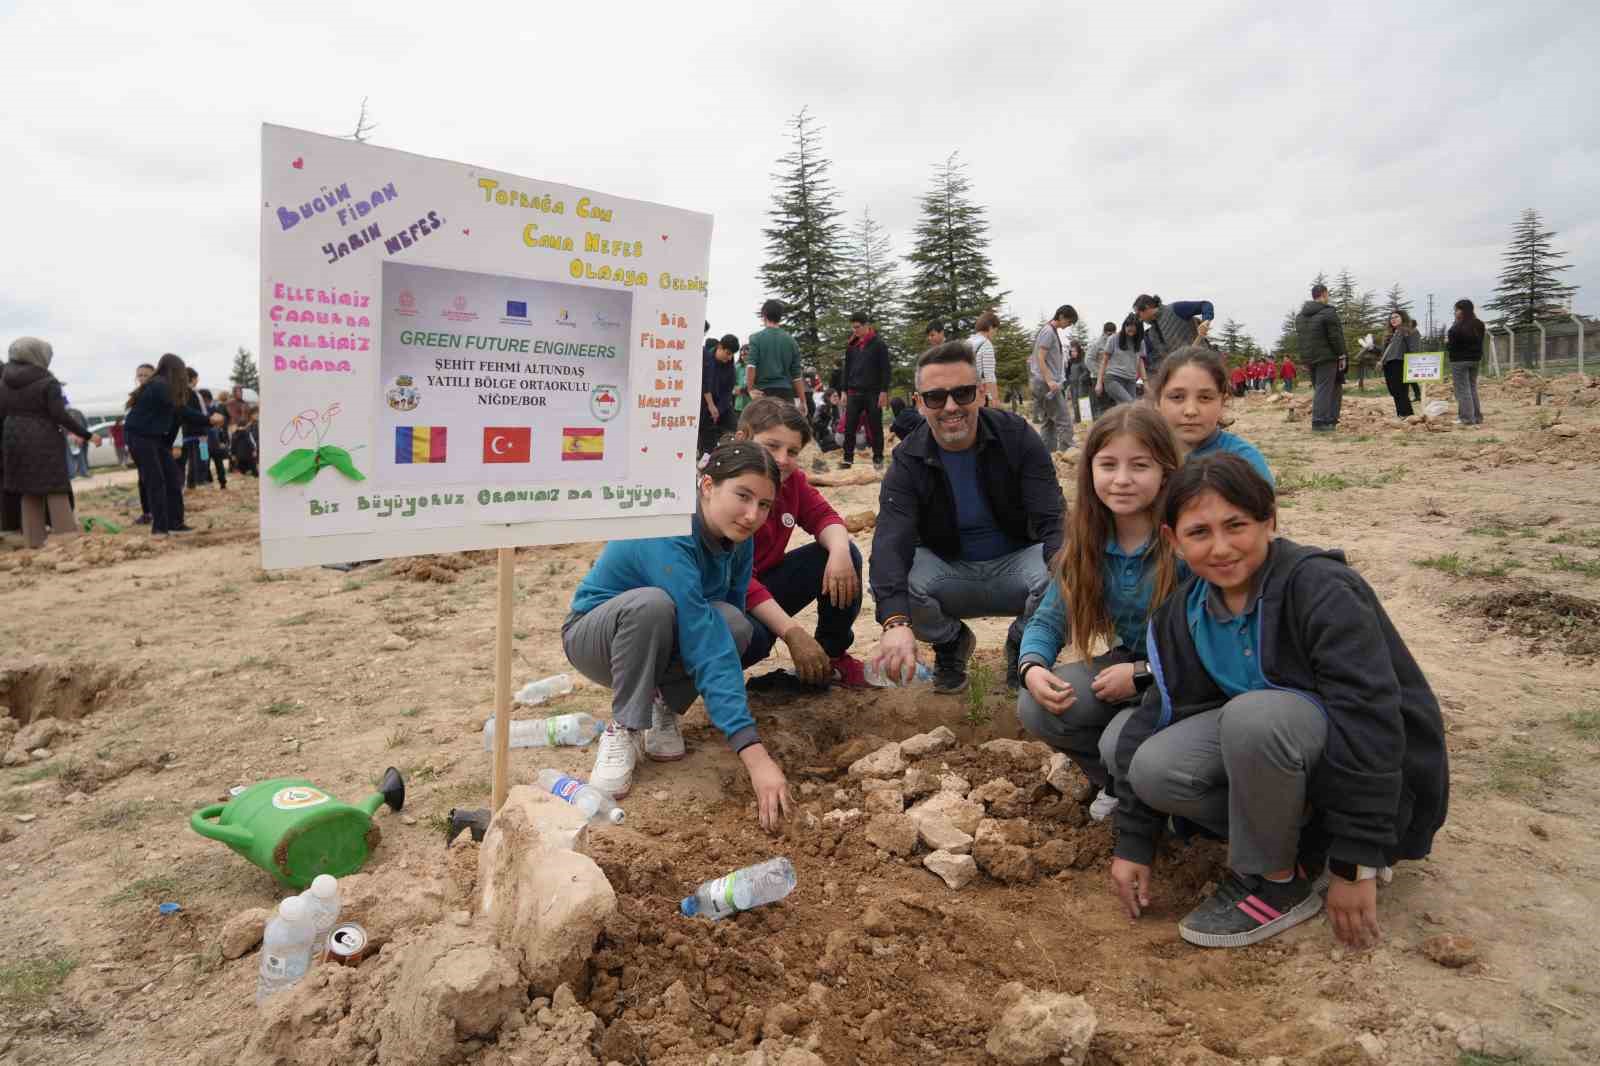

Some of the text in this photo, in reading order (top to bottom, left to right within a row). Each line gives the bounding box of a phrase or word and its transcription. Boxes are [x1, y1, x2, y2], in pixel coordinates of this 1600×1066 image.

[400, 330, 617, 359] GREEN FUTURE ENGINEERS
[435, 357, 585, 377] ŞEHİT FEHMİ ALTUNDAŞ
[426, 375, 470, 388] YATILI
[474, 375, 517, 390] BÖLGE
[520, 381, 590, 393] ORTAOKULU
[478, 393, 547, 407] NİĞDE/BOR
